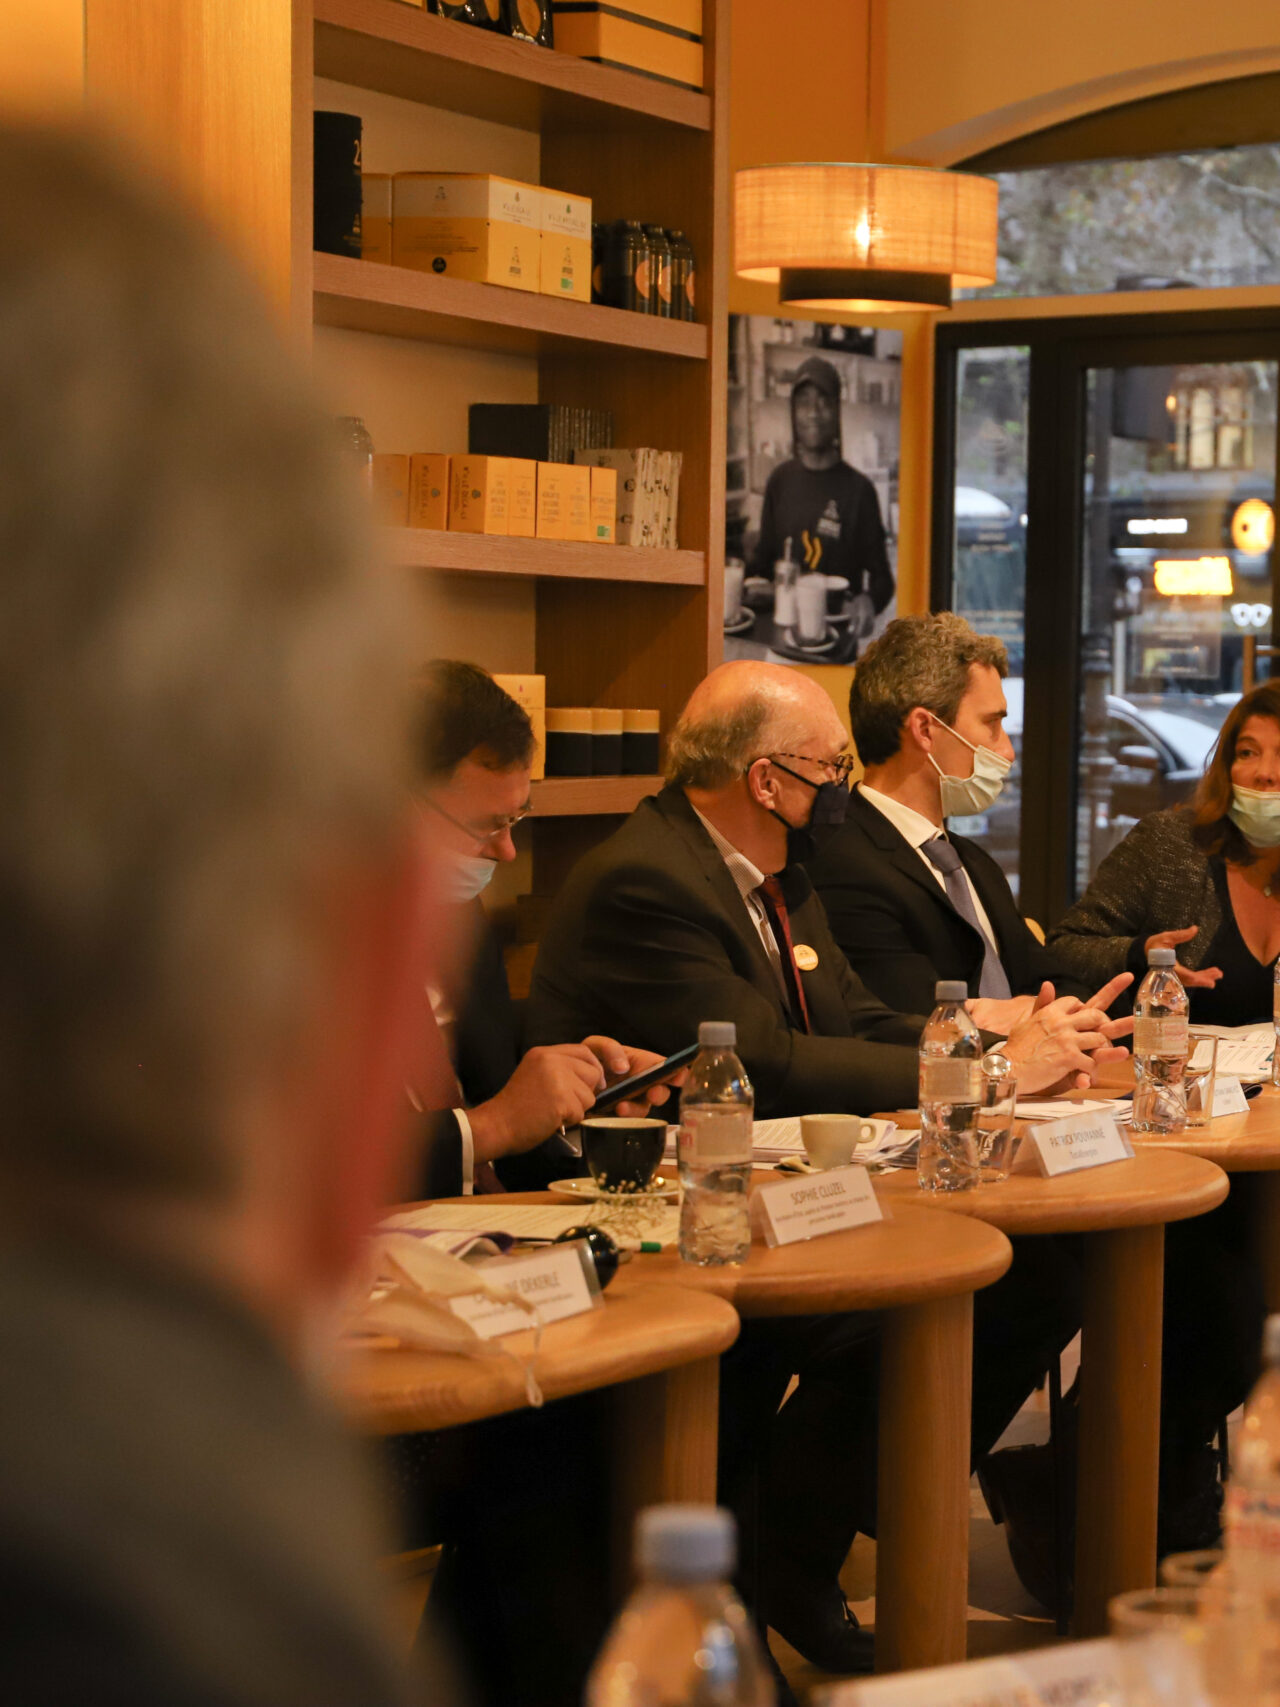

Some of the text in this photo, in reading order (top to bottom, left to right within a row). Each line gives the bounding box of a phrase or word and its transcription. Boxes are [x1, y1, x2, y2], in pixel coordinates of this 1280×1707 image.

[1049, 1132, 1074, 1148] PATRICK
[790, 1187, 819, 1206] SOPHIE
[819, 1181, 847, 1199] CLUZEL
